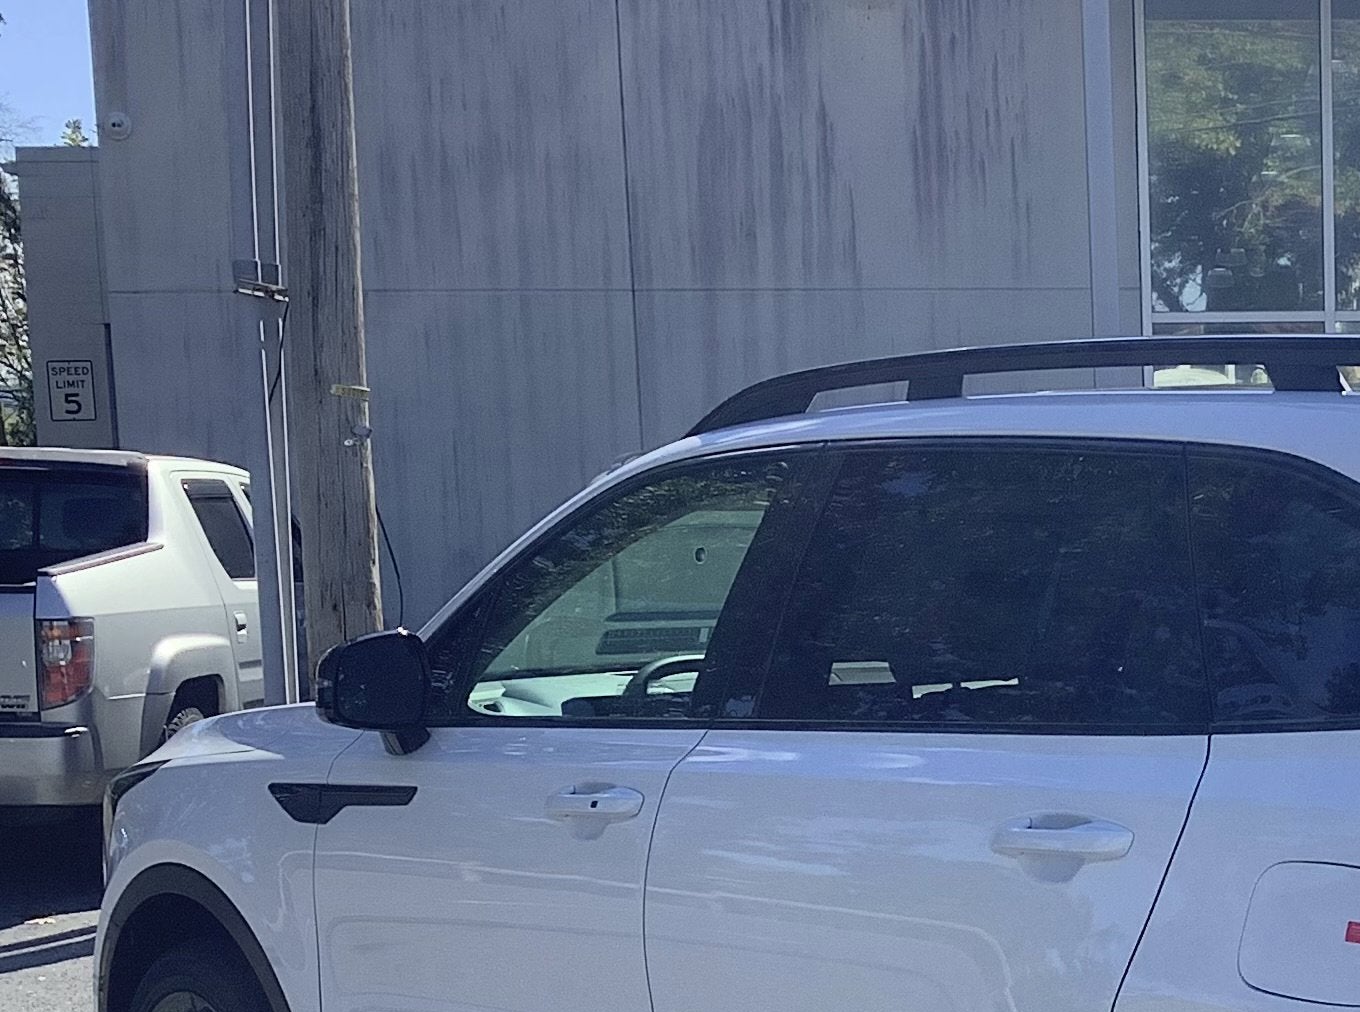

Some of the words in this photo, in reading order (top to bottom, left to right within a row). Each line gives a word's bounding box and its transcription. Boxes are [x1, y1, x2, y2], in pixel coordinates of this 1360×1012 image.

[51, 366, 89, 376] SPEED
[55, 380, 85, 389] LIMIT
[64, 393, 82, 415] 5
